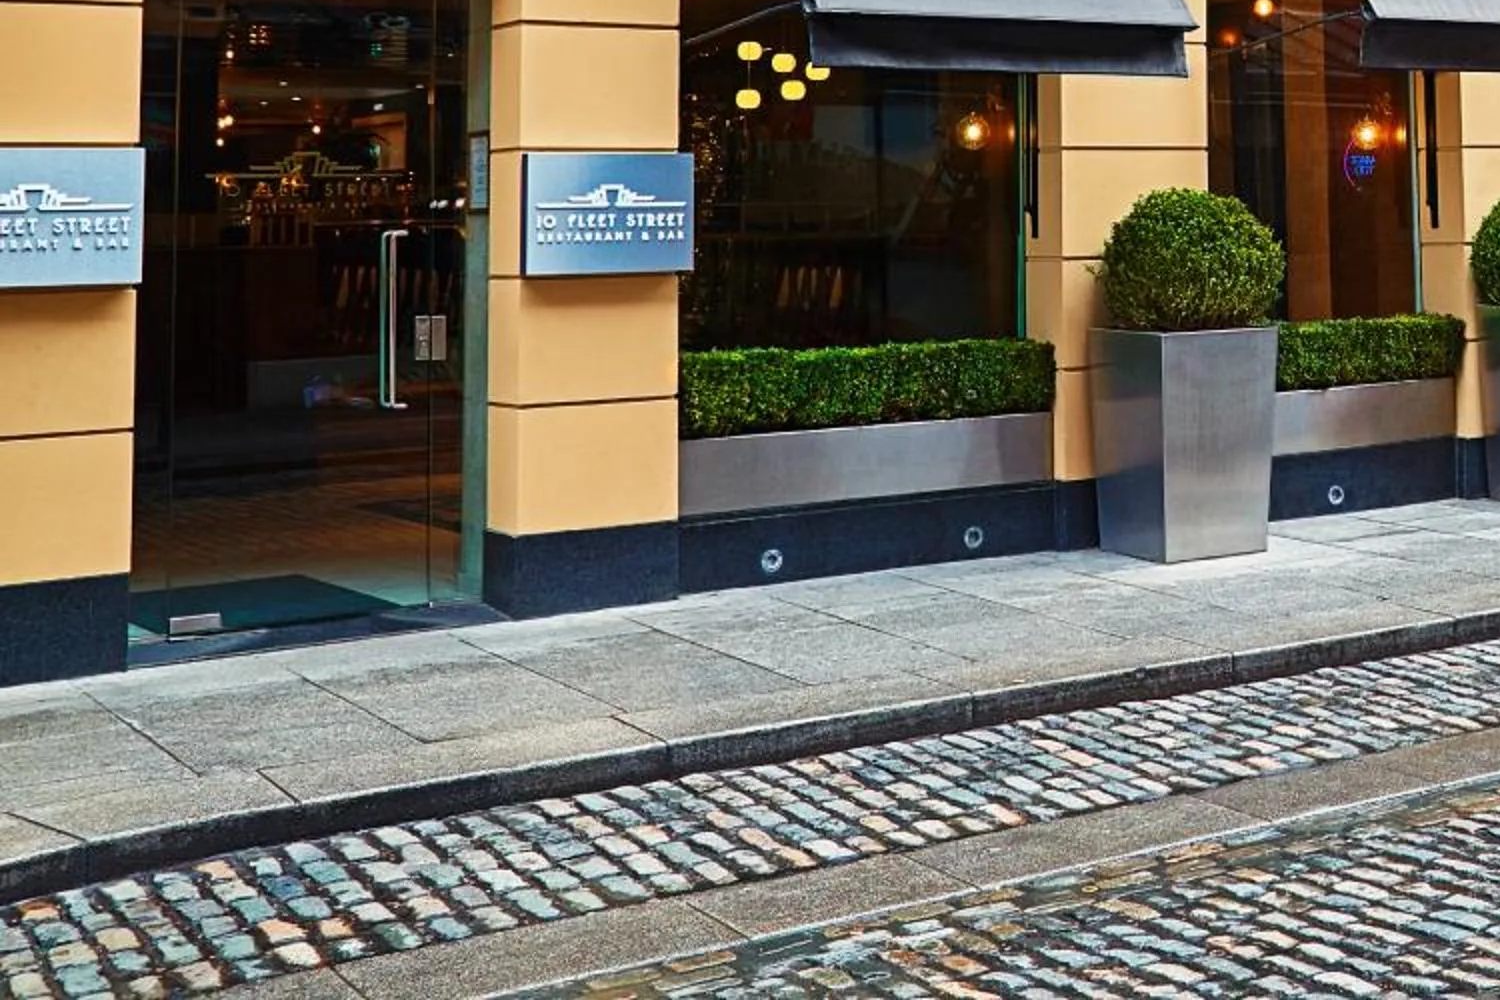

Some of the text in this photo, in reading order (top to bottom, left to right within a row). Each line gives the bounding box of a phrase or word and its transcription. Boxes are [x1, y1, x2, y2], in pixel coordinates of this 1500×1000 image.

[0, 216, 131, 233] EET STREET
[567, 213, 617, 228] FLEET
[626, 213, 685, 228] STREET
[537, 231, 633, 242] RESTAURANT
[657, 230, 685, 241] BAR
[95, 237, 129, 250] BAR
